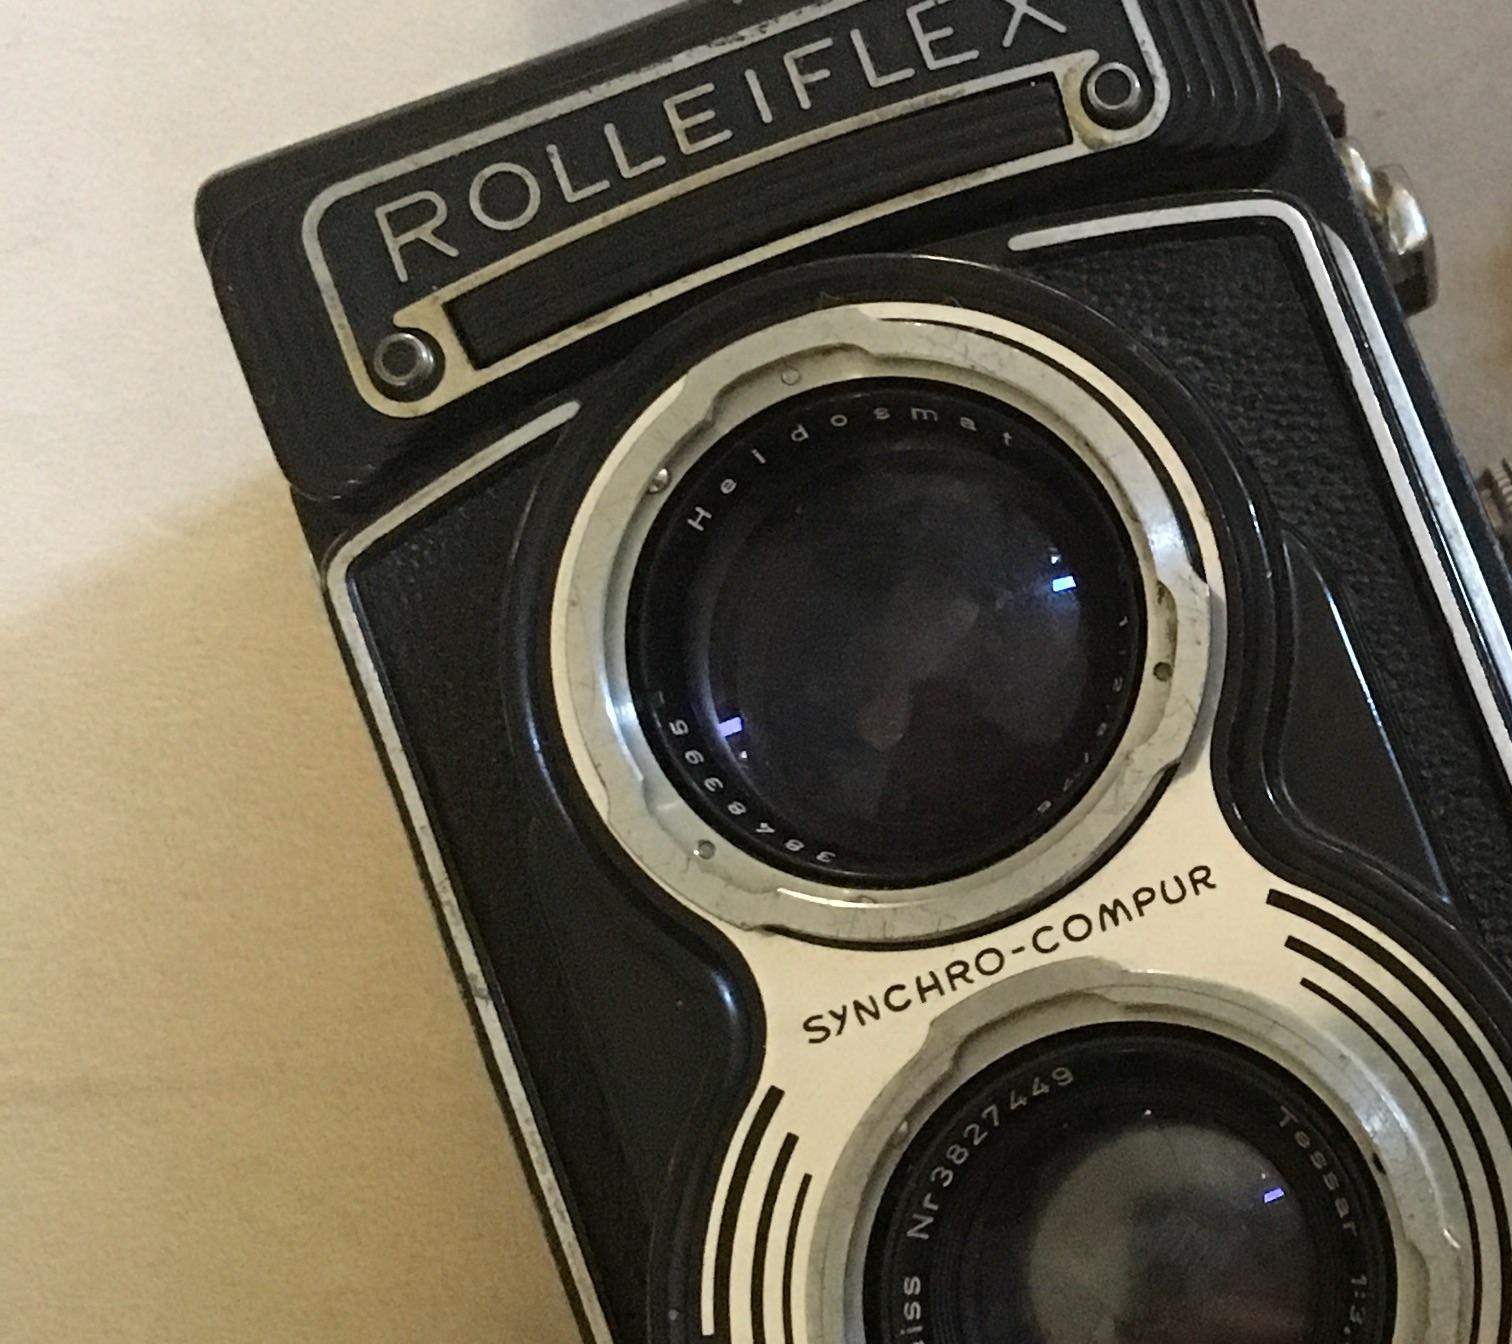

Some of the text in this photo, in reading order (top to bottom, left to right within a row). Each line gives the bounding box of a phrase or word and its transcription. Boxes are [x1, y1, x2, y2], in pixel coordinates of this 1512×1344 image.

[687, 403, 1013, 533] Heidosmat
[802, 864, 1217, 1045] SYNCHRO-COMPUR
[1278, 1104, 1359, 1238] Tessar
